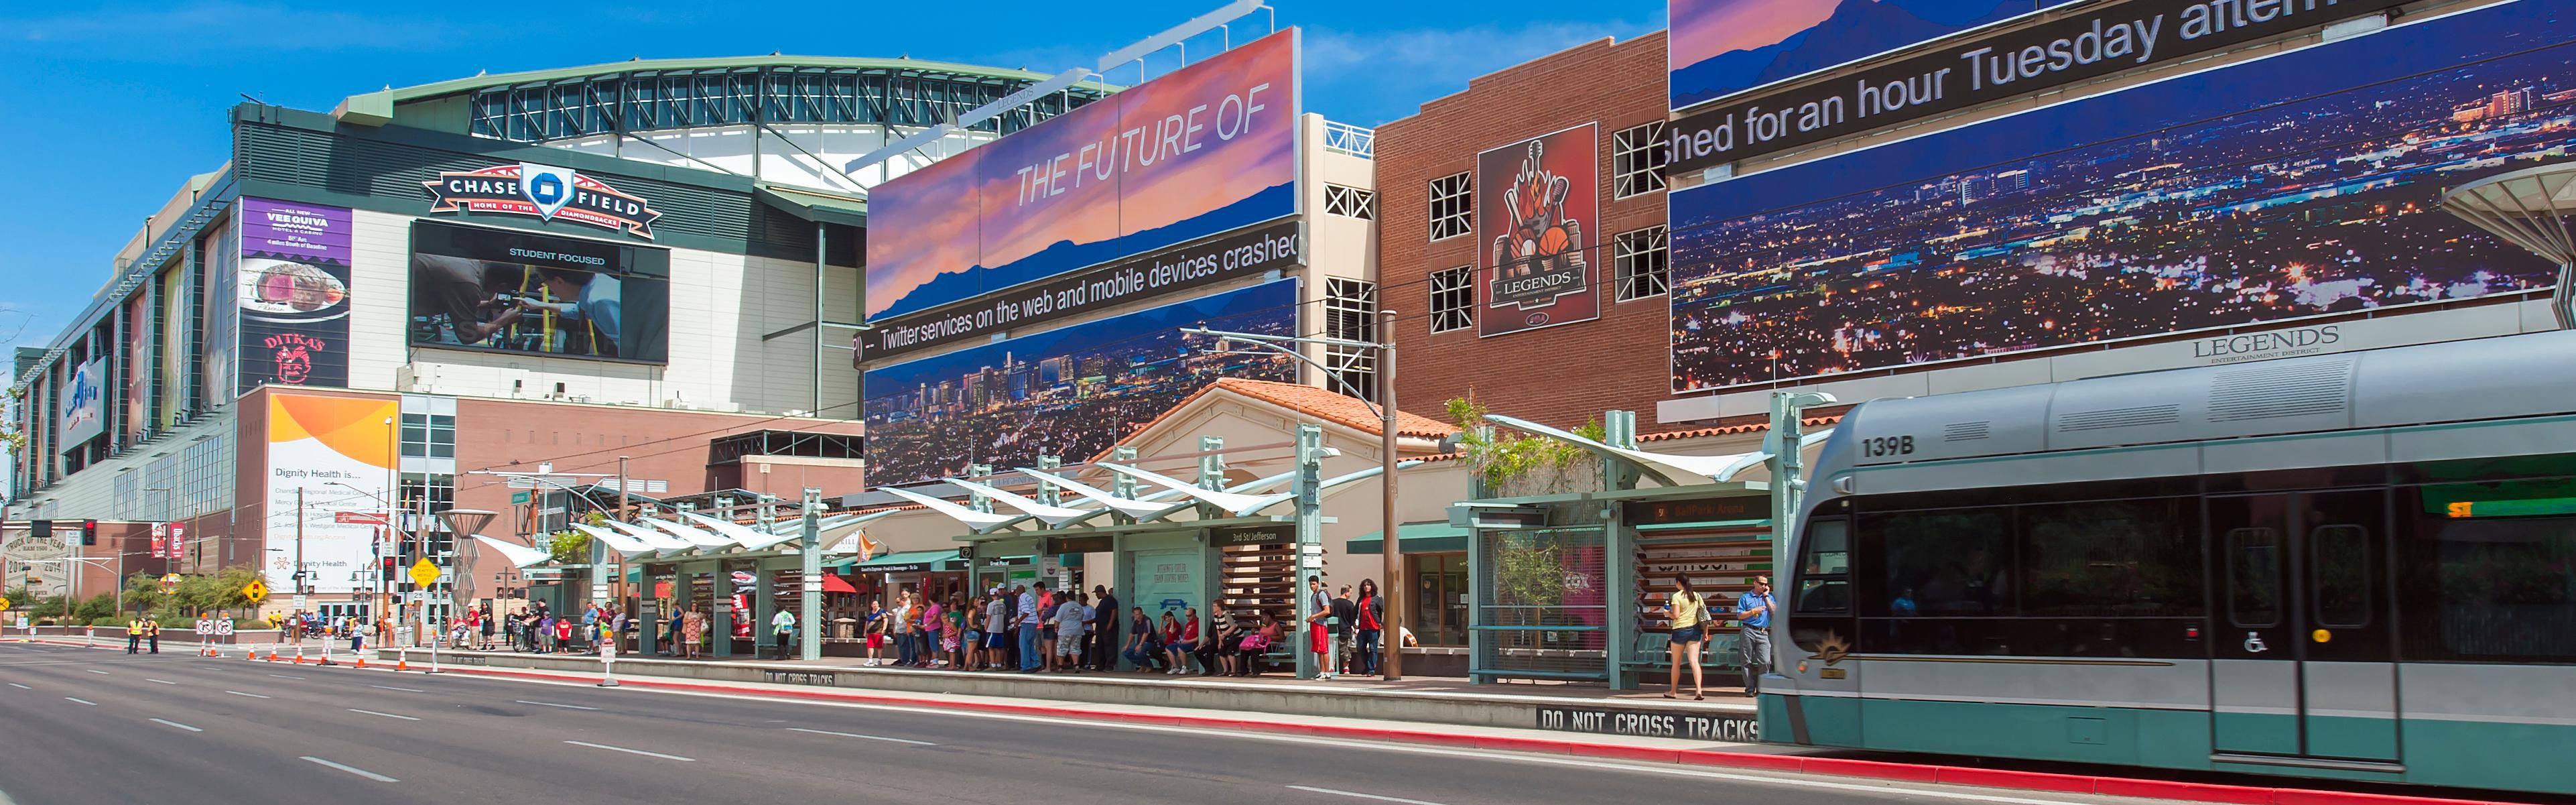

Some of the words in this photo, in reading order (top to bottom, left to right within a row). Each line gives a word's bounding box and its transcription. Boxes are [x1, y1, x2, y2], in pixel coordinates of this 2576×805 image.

[1744, 106, 1793, 145] for
[1797, 96, 1844, 133] an
[1858, 68, 1950, 119] hour
[1961, 14, 2163, 90] Tuesday
[998, 87, 1033, 107] LEGENDS
[1017, 152, 1070, 206] THE
[1076, 105, 1206, 188] FUTURE
[1216, 83, 1269, 141] OF
[450, 180, 517, 195] CHASE
[578, 192, 639, 215] FIELD
[267, 212, 291, 222] VEE
[292, 215, 328, 227] QUIVA
[561, 210, 617, 225] DIAMONDBACKS
[509, 248, 556, 260] STUDENT
[558, 253, 605, 265] FOCUSED
[1504, 271, 1571, 294] LEGENDS
[881, 327, 920, 351] Twitter
[921, 314, 972, 341] services
[976, 311, 992, 328] on
[996, 300, 1018, 324] the
[1023, 290, 1052, 318] web
[1056, 280, 1086, 310] and
[1090, 267, 1144, 302] mobile
[1149, 254, 1217, 292] devices
[2193, 326, 2339, 358] LEGENDS
[2211, 352, 2280, 364] ENTERTAINMENT
[2282, 347, 2321, 357] DISTRICT
[1862, 434, 1914, 458] 139B
[275, 468, 308, 479] Dignity
[311, 469, 341, 479] Health
[344, 470, 361, 479] is...
[5, 538, 25, 552] TRUCK
[50, 537, 66, 552] YEAR
[1233, 534, 1242, 542] 3rd
[765, 672, 773, 682] DO
[775, 672, 786, 683] NOT
[788, 673, 807, 684] CROSS
[810, 674, 832, 685] TRACKS
[1543, 709, 1563, 730] DO
[1573, 711, 1605, 732] NOT
[1616, 713, 1674, 736] CROSS
[1685, 717, 1758, 741] TRACKS
